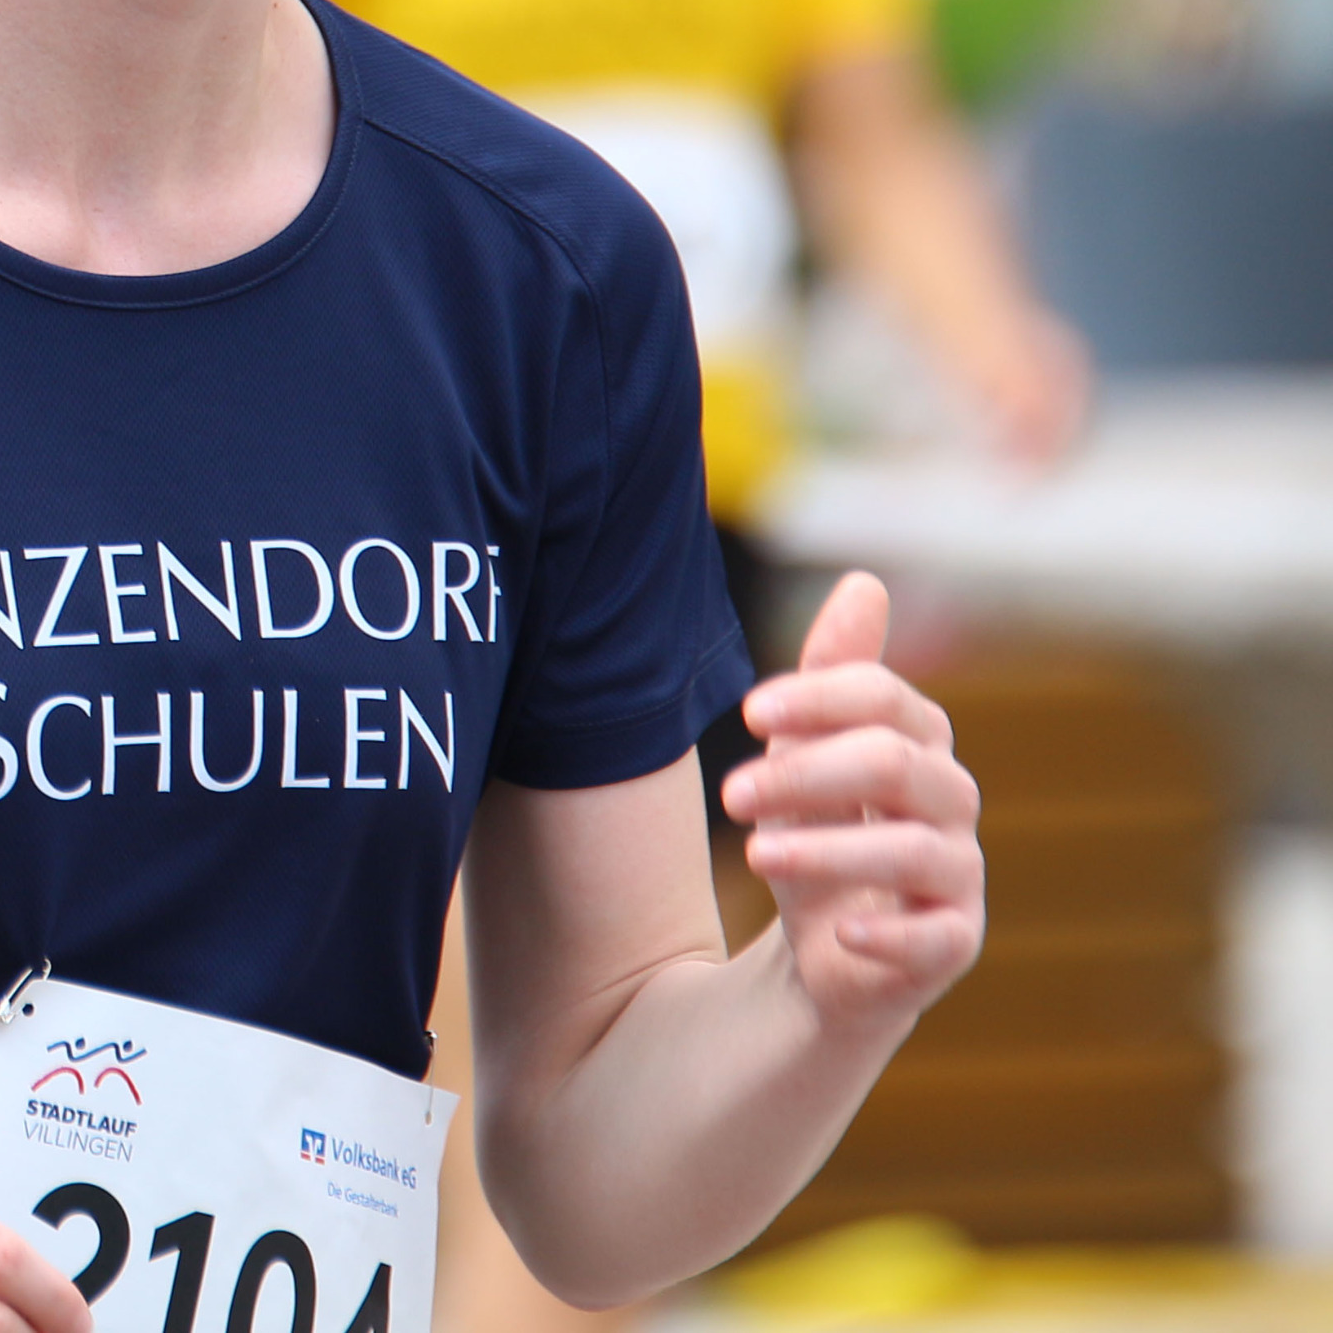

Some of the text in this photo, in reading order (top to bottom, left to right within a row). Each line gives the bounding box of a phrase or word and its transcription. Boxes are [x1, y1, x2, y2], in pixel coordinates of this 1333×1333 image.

[23, 1118, 133, 1163] VILLINGEN
[25, 1098, 138, 1138] STADTLAUF
[332, 1136, 417, 1189] Volksbank eG
